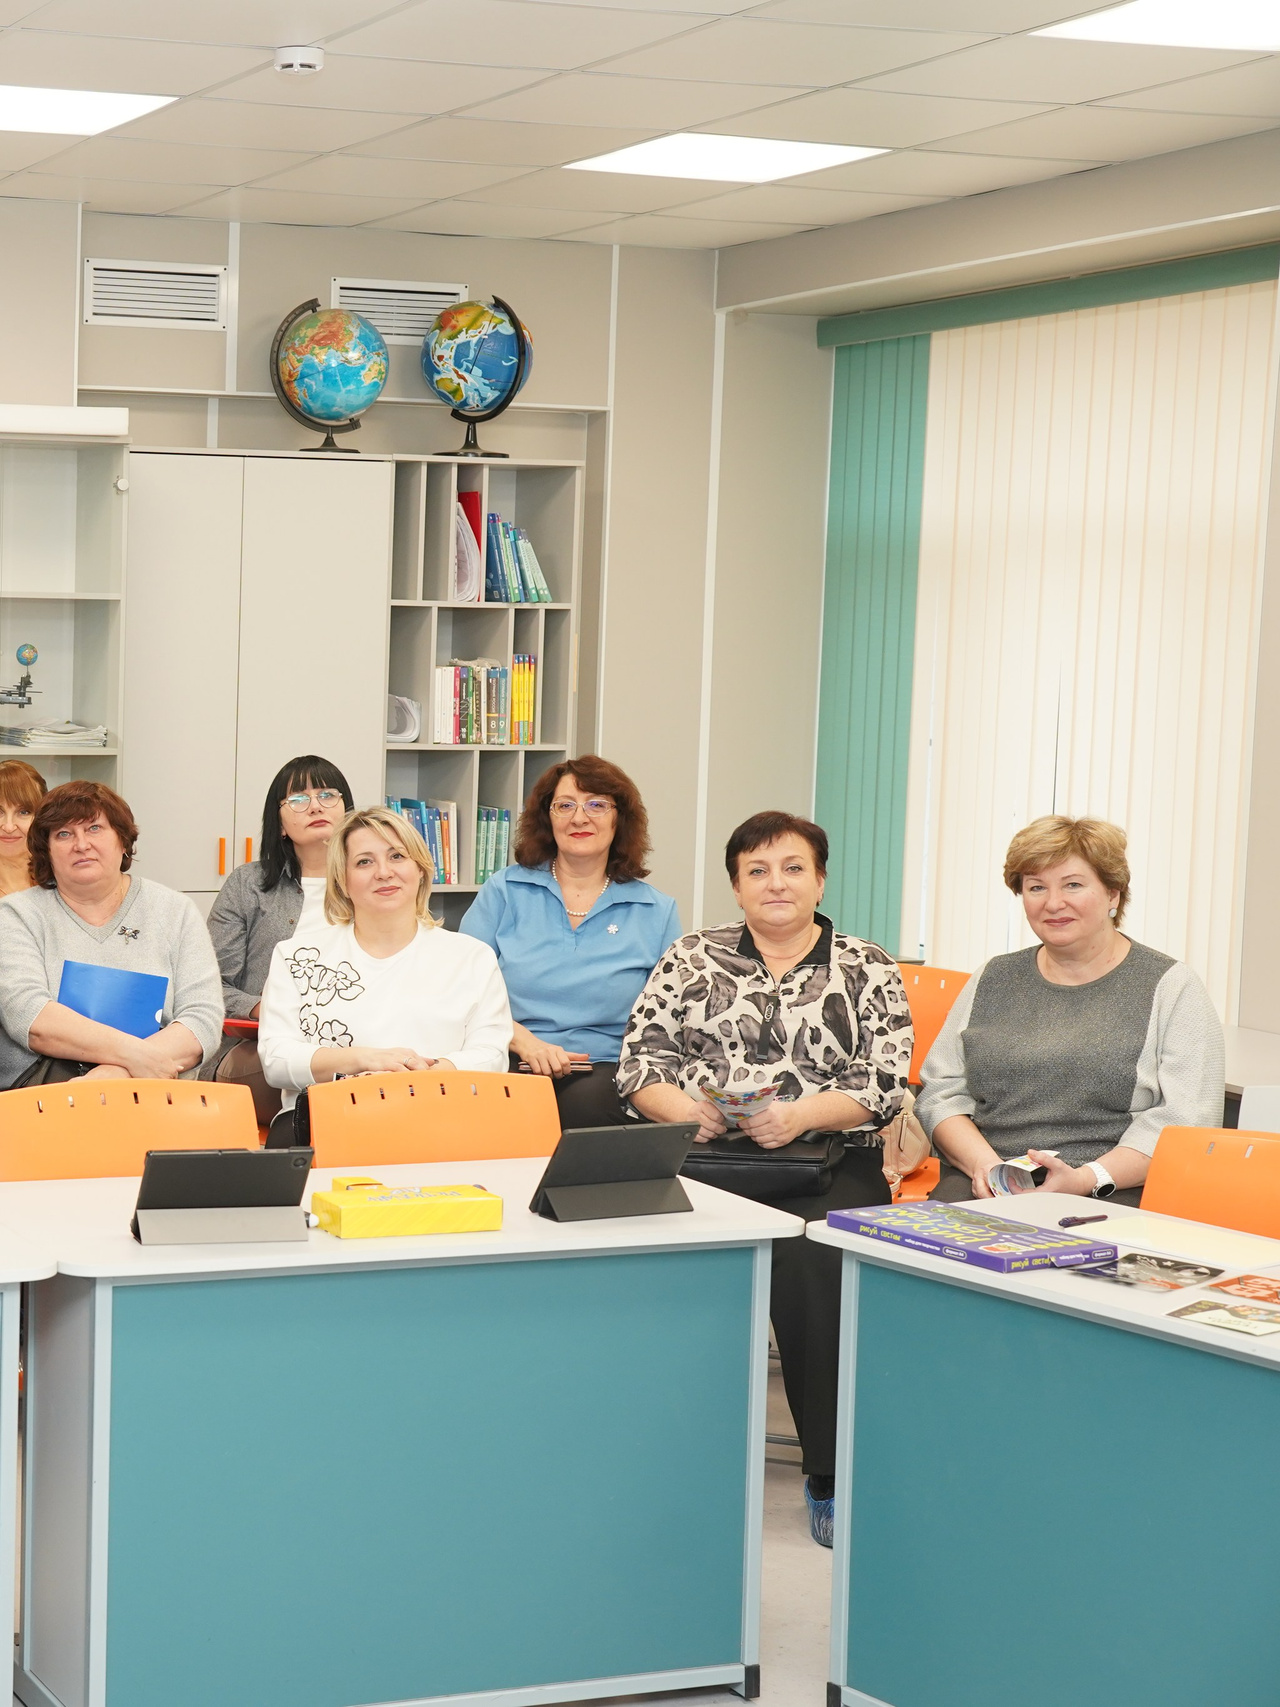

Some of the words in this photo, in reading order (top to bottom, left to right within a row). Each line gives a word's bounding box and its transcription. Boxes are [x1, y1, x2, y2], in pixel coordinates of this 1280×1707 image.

[491, 721, 496, 729] 8
[499, 721, 505, 729] 9
[860, 1225, 878, 1236] рисуй
[880, 1231, 901, 1241] светом
[1011, 1258, 1029, 1269] рисуй
